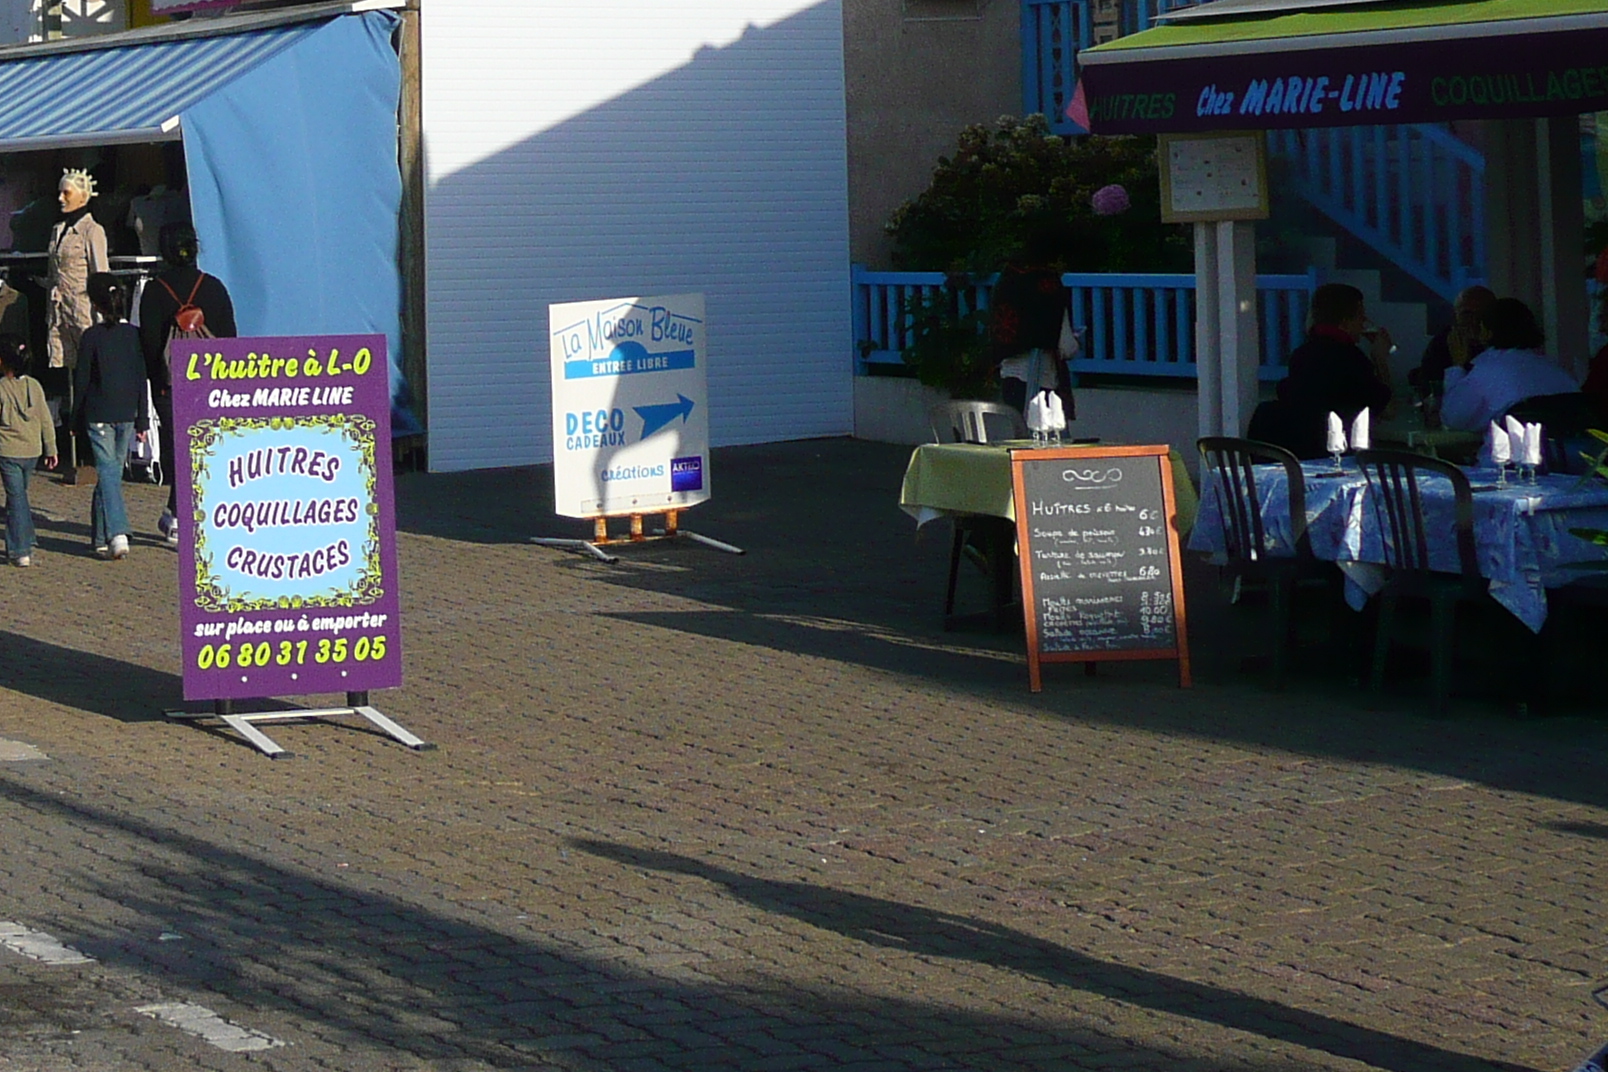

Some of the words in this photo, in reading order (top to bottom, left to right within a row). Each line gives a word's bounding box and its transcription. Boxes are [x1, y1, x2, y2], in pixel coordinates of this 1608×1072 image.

[1089, 91, 1176, 121] HUITRES
[1196, 83, 1232, 118] Chez
[1239, 71, 1406, 116] MARIE-LINE
[562, 333, 583, 360] La
[586, 311, 644, 360] Maison
[649, 306, 694, 346] Bleue
[303, 349, 323, 376] à
[636, 356, 669, 371] LIBRE
[208, 389, 251, 408] Chez
[252, 388, 310, 407] MARIE
[312, 386, 354, 405] LINE
[565, 408, 625, 435] DECO
[566, 431, 626, 451] CADEAUX
[228, 446, 341, 488] HUITRES
[600, 464, 665, 482] créations
[213, 498, 359, 533] COQUILLAGES
[226, 539, 351, 579] CRUSTACES
[194, 622, 225, 638] sur
[225, 616, 272, 640] place
[273, 618, 295, 633] ou
[298, 613, 310, 632] à
[312, 612, 388, 635] emporter
[196, 643, 231, 670] 06
[236, 641, 272, 667] 80
[275, 639, 307, 666] 31
[314, 637, 349, 665] 35
[352, 635, 388, 662] 05
